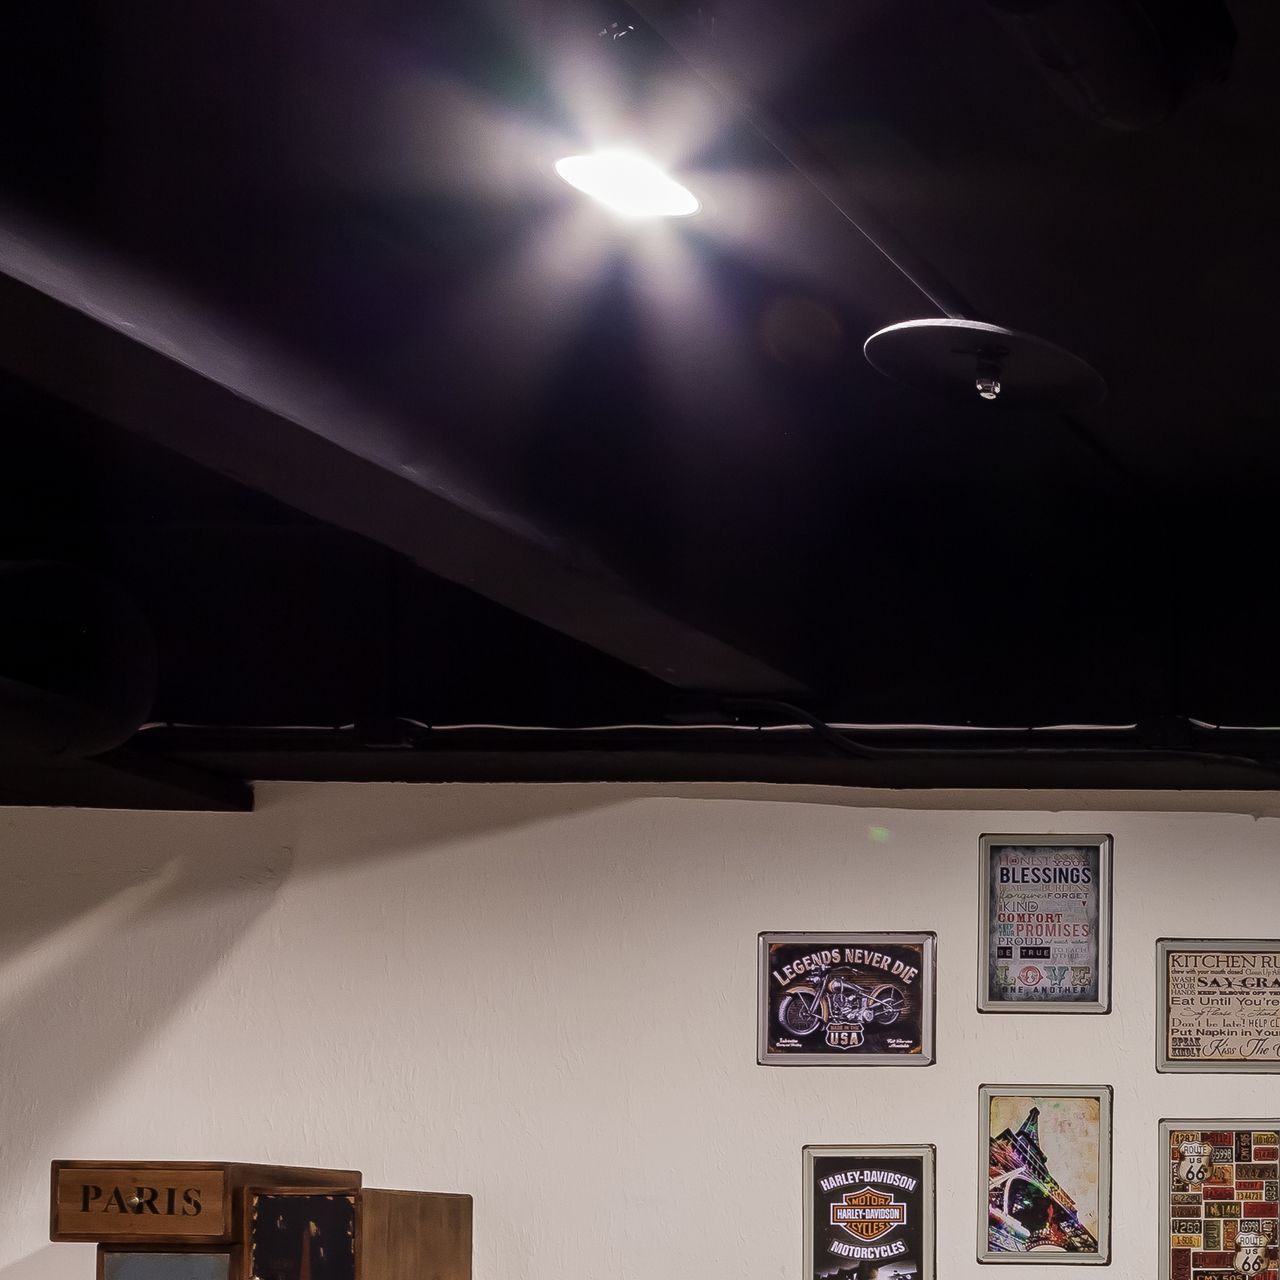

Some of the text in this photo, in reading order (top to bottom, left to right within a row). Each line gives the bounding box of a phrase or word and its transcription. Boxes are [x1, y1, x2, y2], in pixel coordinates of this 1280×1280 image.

[1000, 867, 1091, 884] BLESSINGS
[998, 913, 1063, 922] COMFORT
[1016, 924, 1090, 937] PROMISES
[997, 938, 1044, 946] PROUD
[773, 948, 918, 986] LEGENDS NEVER DIE
[1171, 954, 1256, 968] KITCHEN
[996, 965, 1092, 986] LOVE
[1197, 977, 1234, 988] SAY
[1002, 986, 1088, 994] ONE ANOTHER
[1171, 997, 1195, 1006] Eat
[1200, 997, 1231, 1006] Until
[1236, 997, 1280, 1006] You're
[1172, 1018, 1200, 1028] Don't
[1206, 1018, 1218, 1028] be
[1223, 1018, 1246, 1028] late!
[1248, 1018, 1267, 1028] HELP
[1196, 1028, 1238, 1036] Napkin
[830, 1032, 859, 1046] USA
[1171, 1037, 1201, 1047] SPEAK
[1171, 1048, 1202, 1058] KINDLY
[1202, 1038, 1237, 1058] Kiss
[1240, 1038, 1270, 1058] The
[1184, 1146, 1208, 1154] ROUTE
[1186, 1164, 1206, 1181] 66
[820, 1170, 918, 1192] HARLEY-DAVIDSON
[80, 1184, 202, 1216] PARIS
[852, 1196, 886, 1206] MOTOR
[836, 1208, 900, 1220] HARLEY-DAVIDSON
[851, 1222, 885, 1236] CYCLES
[1240, 1236, 1263, 1246] ROUTE
[830, 1240, 906, 1259] MOTORCYCLES
[1242, 1255, 1262, 1272] 66
